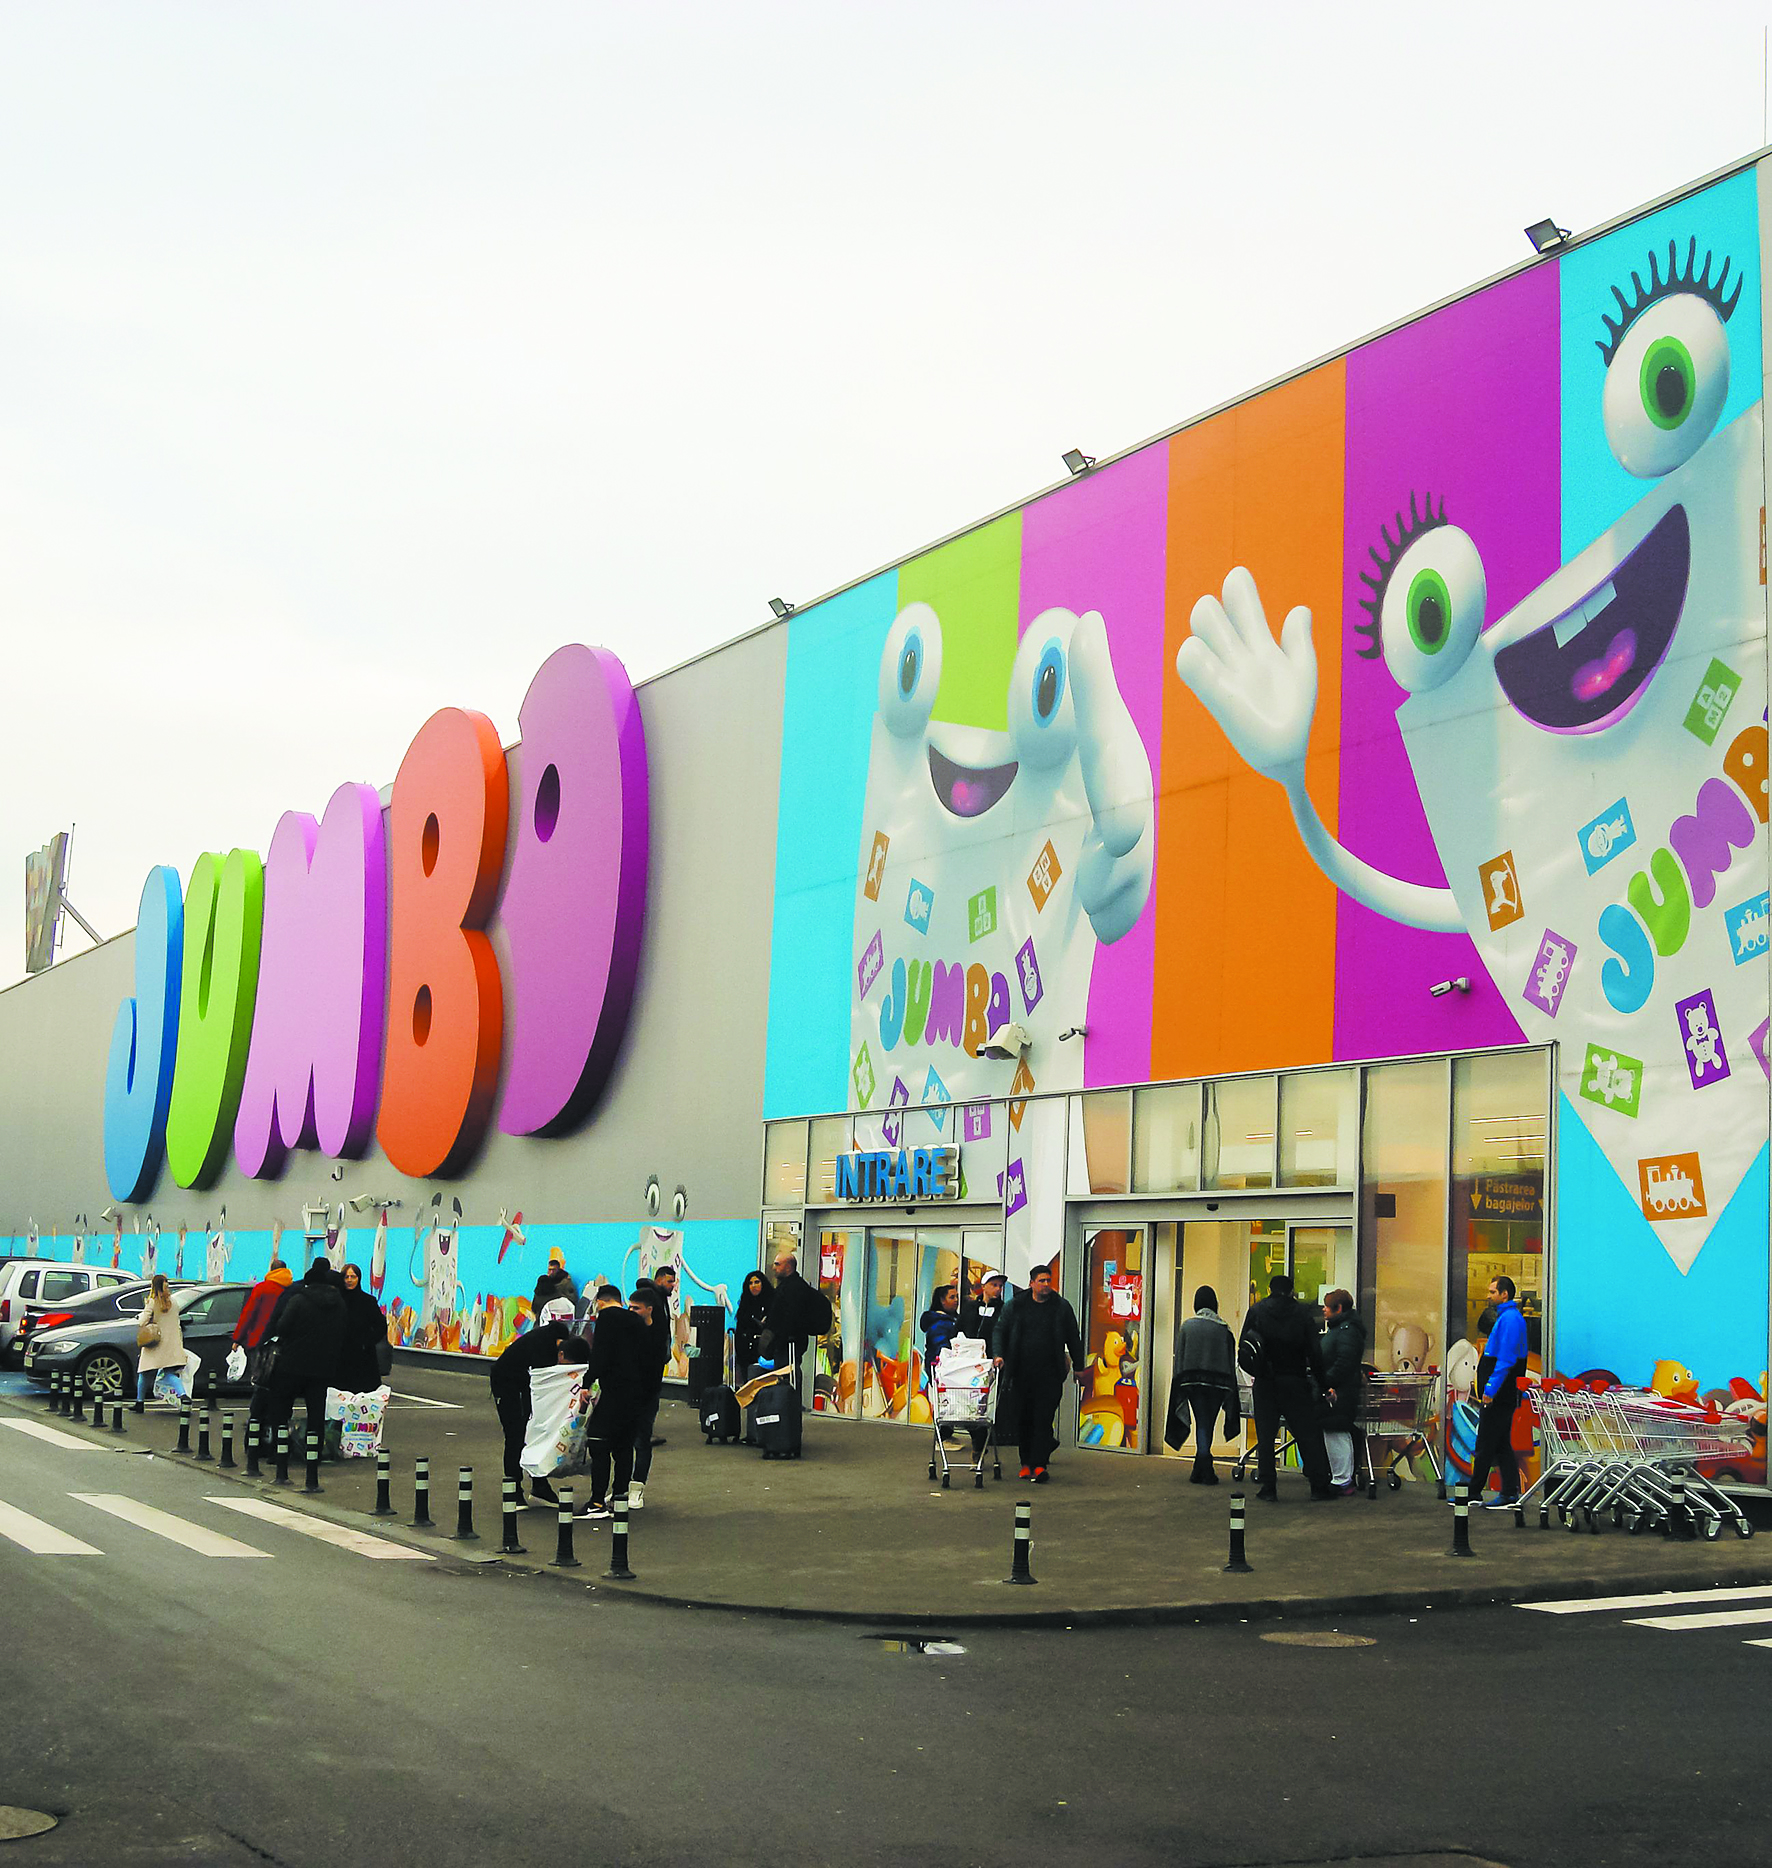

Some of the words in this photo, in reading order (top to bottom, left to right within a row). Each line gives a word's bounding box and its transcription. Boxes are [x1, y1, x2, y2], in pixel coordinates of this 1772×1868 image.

[104, 643, 648, 1203] JUMBO
[1598, 704, 1768, 1014] JUMB
[835, 1147, 950, 1199] INTRARE
[1486, 1194, 1535, 1213] bagajelor
